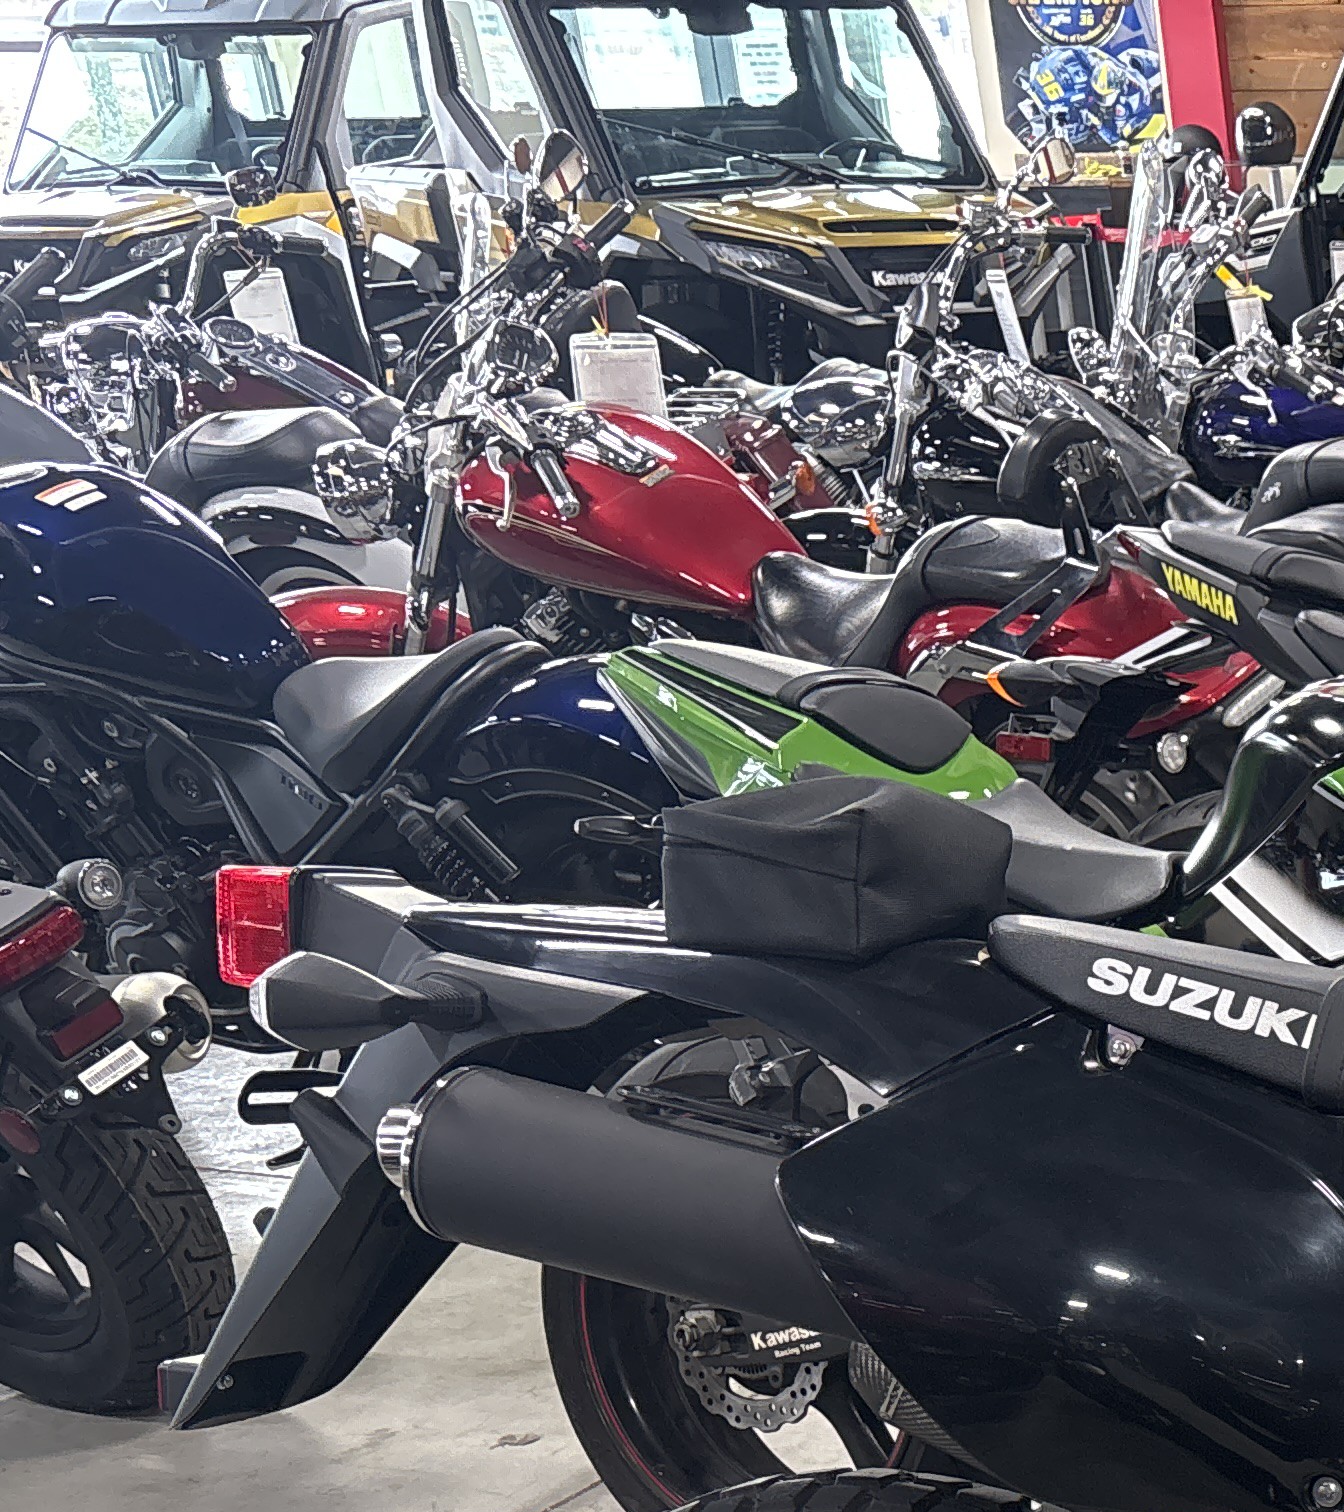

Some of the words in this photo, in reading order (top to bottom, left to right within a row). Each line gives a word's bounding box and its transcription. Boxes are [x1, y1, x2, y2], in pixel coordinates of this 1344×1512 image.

[1035, 68, 1065, 102] 36
[1160, 561, 1239, 626] YAMAHA
[1086, 957, 1318, 1050] SUZUKI
[750, 1326, 823, 1351] Kawas
[800, 1341, 822, 1352] Team
